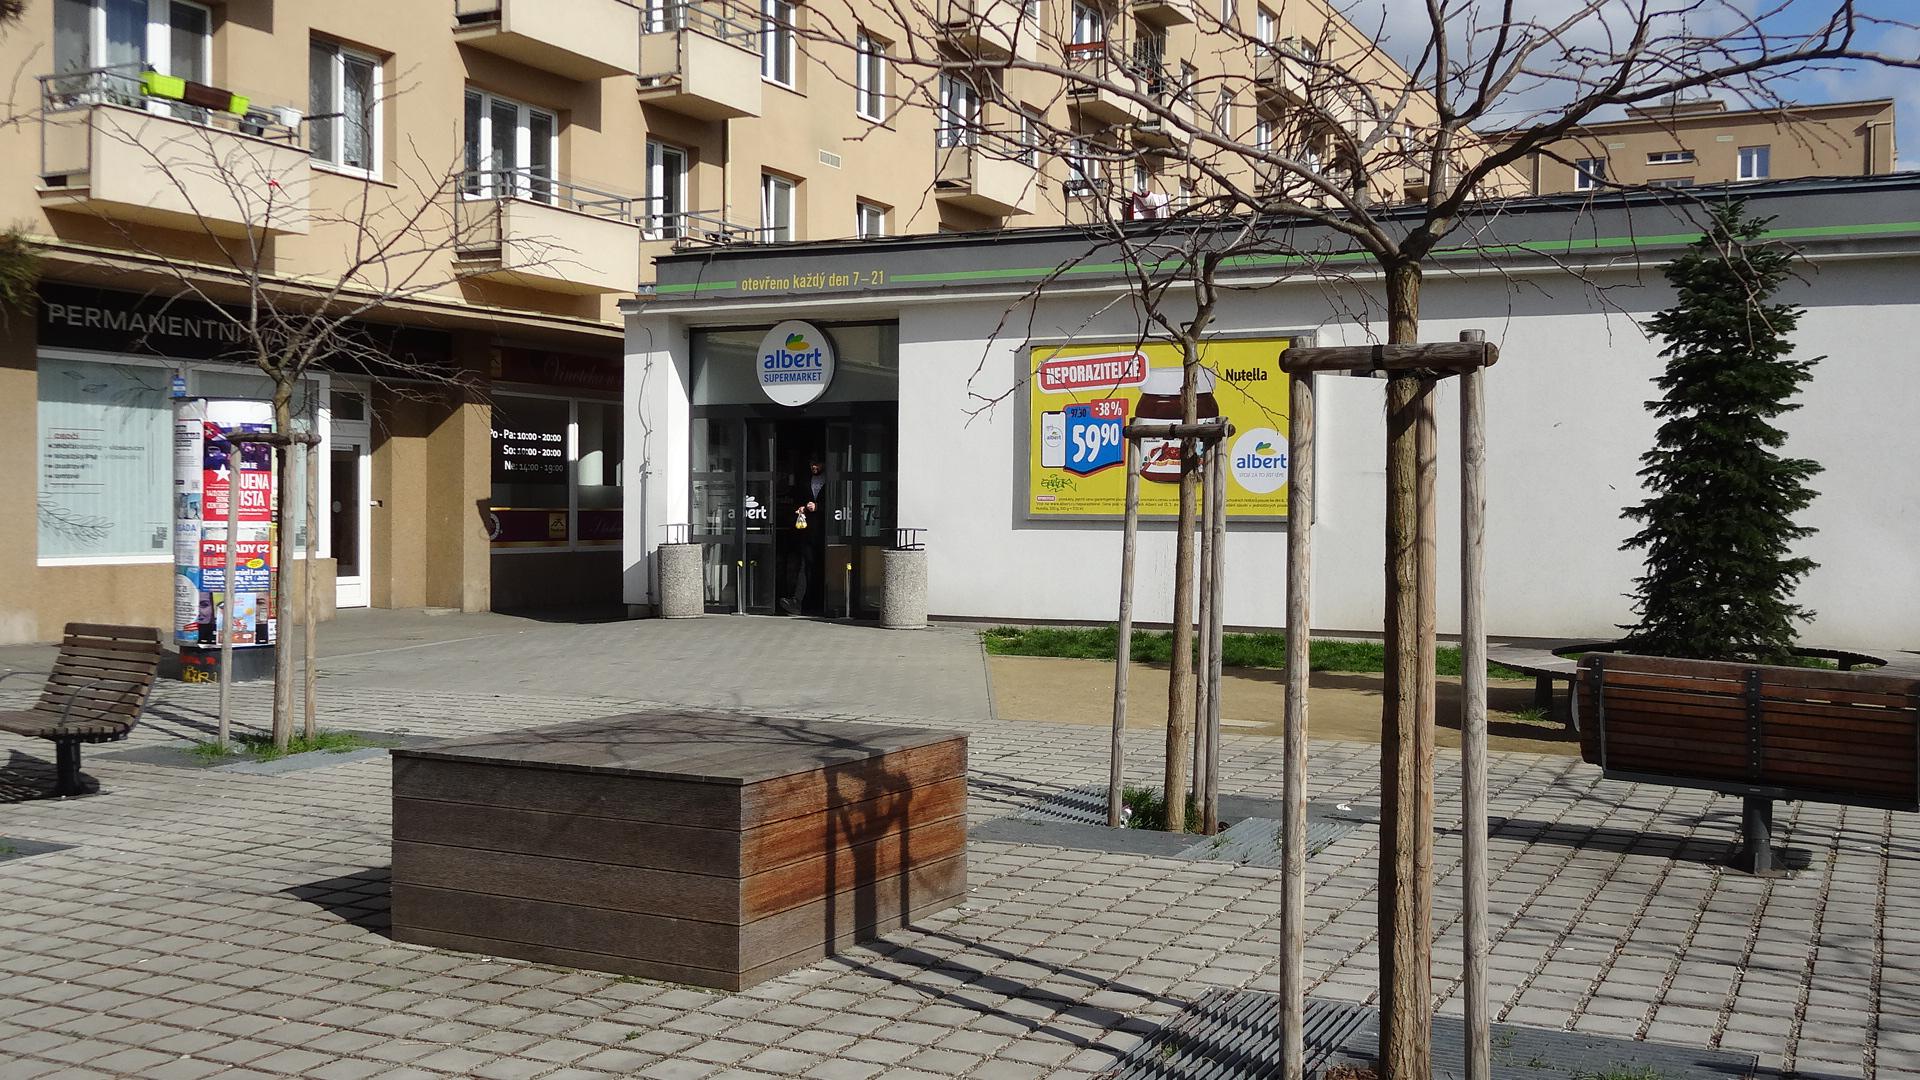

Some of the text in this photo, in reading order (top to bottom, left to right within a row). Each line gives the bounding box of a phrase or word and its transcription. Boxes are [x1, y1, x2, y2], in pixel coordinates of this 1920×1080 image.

[741, 275, 789, 291] otevřeno
[793, 271, 825, 289] každý
[828, 272, 849, 287] den
[764, 347, 823, 369] albert
[764, 372, 822, 383] SUPERMARKET
[1046, 357, 1140, 385] NEPORAZITELNÉ
[1225, 367, 1268, 381] Nutella
[517, 432, 537, 441] 10:00
[542, 433, 562, 442] 20:00
[503, 444, 516, 455] So:
[517, 447, 537, 456] 10:00
[542, 448, 562, 457] 20:00
[504, 460, 518, 471] Ne:
[1236, 453, 1287, 469] albert
[240, 473, 270, 490] UENA
[240, 490, 266, 507] ISTA
[728, 505, 767, 519] aert
